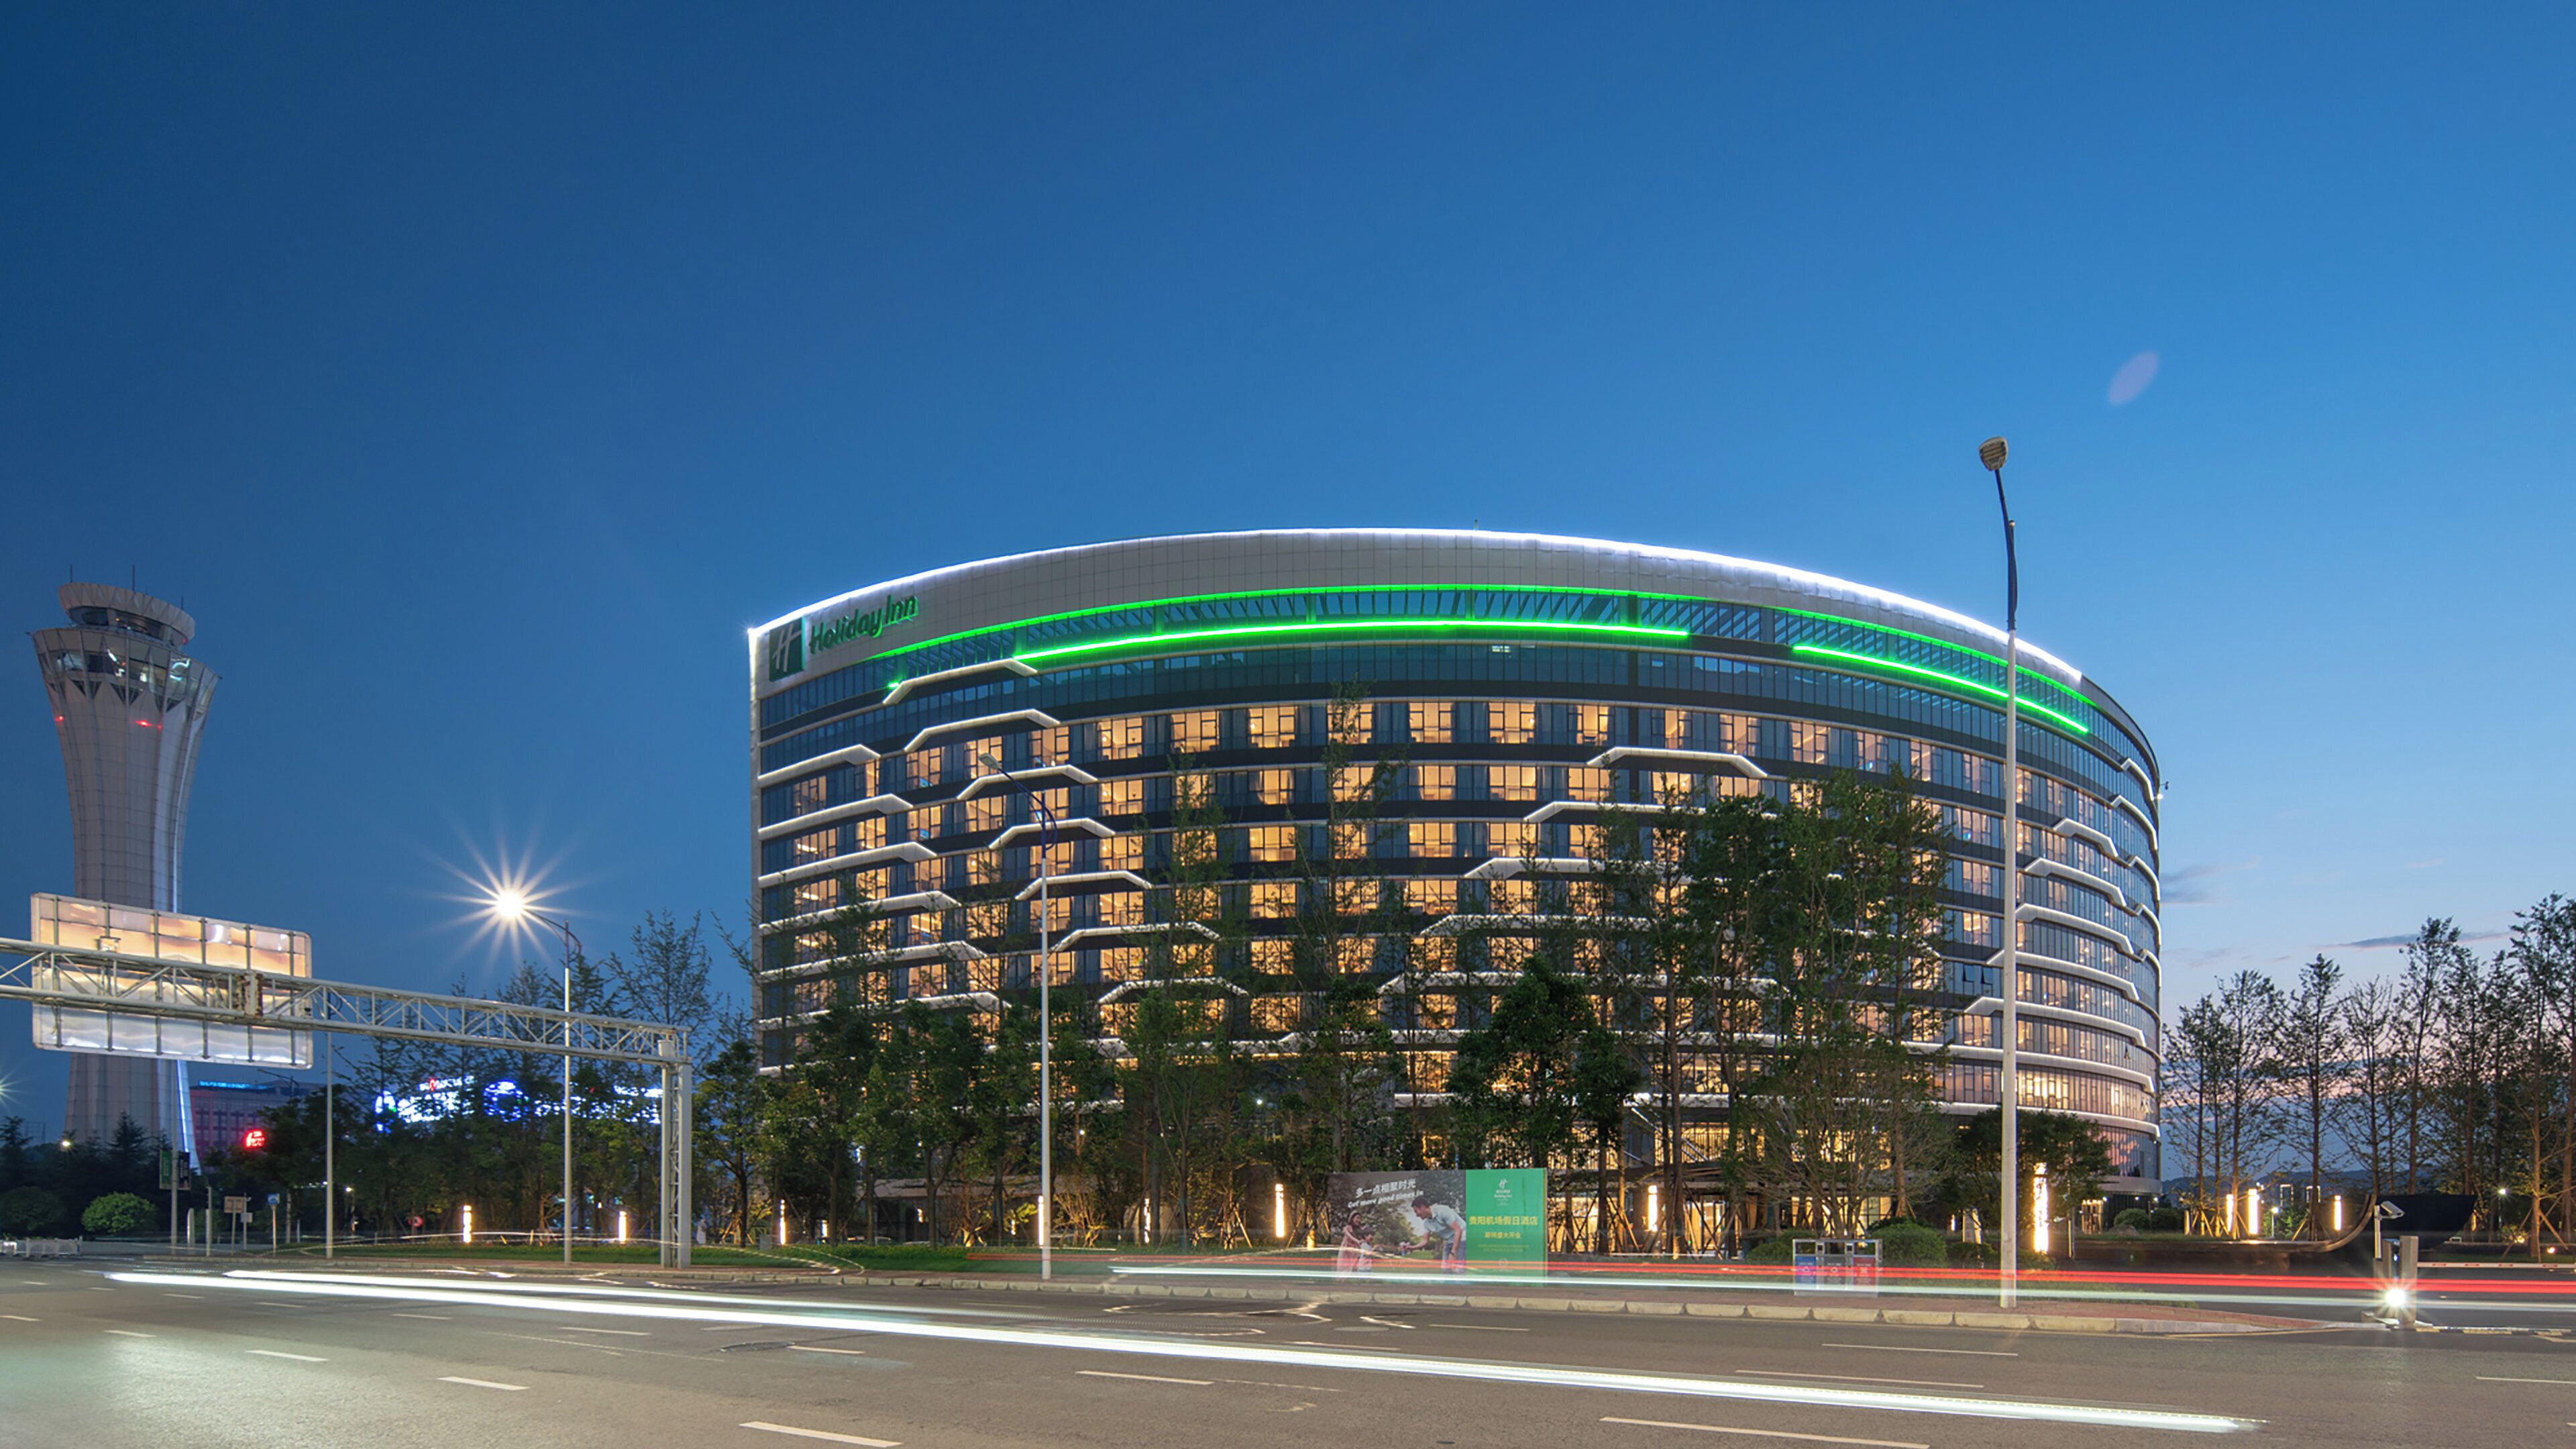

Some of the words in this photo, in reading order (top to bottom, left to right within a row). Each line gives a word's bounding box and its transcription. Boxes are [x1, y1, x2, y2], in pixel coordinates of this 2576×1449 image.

[809, 608, 883, 655] Holiday
[885, 594, 919, 625] Inn
[1348, 1200, 1359, 1208] Get
[1359, 1198, 1377, 1206] more
[1377, 1193, 1395, 1205] good
